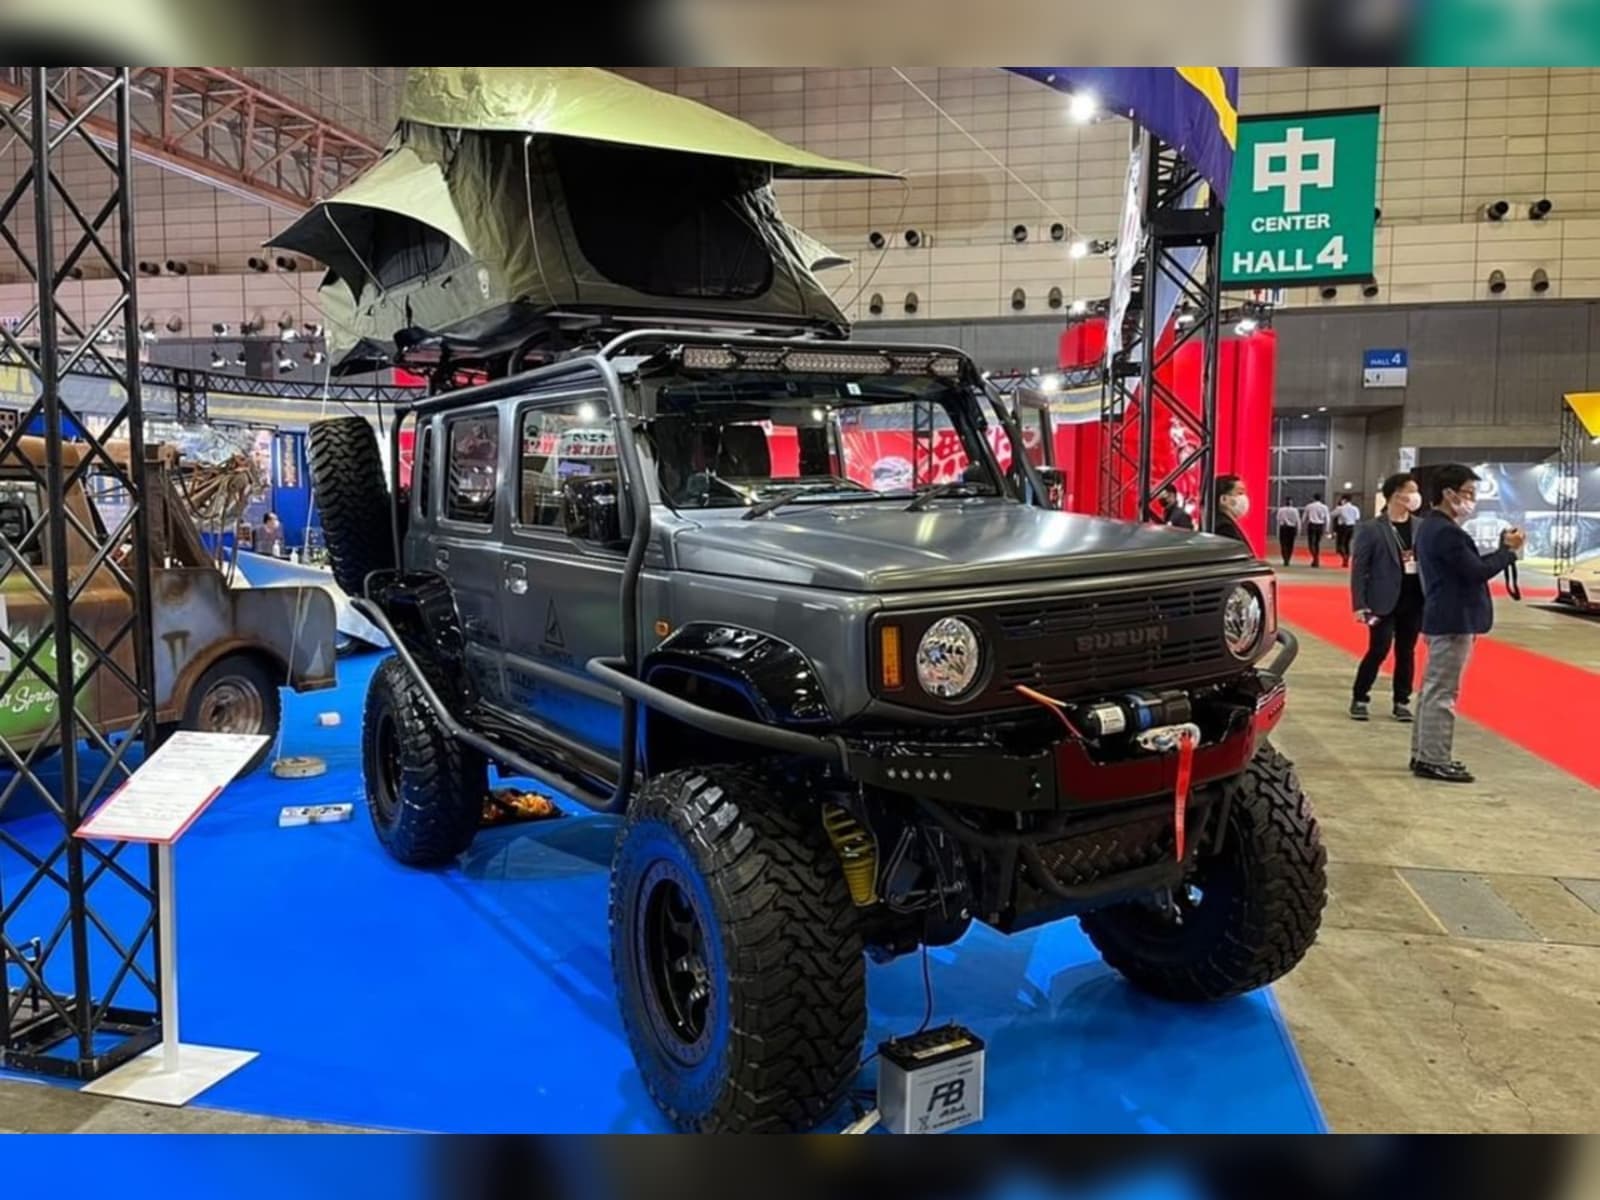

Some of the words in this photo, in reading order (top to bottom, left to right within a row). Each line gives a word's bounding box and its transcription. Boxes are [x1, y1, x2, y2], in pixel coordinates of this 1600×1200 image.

[1253, 127, 1335, 212] 中
[1251, 213, 1331, 233] CENTER
[1232, 248, 1313, 274] HALL
[1316, 235, 1348, 270] 4
[1391, 353, 1401, 365] 4
[1077, 625, 1167, 651] SUZUKI
[927, 1079, 965, 1112] FB
